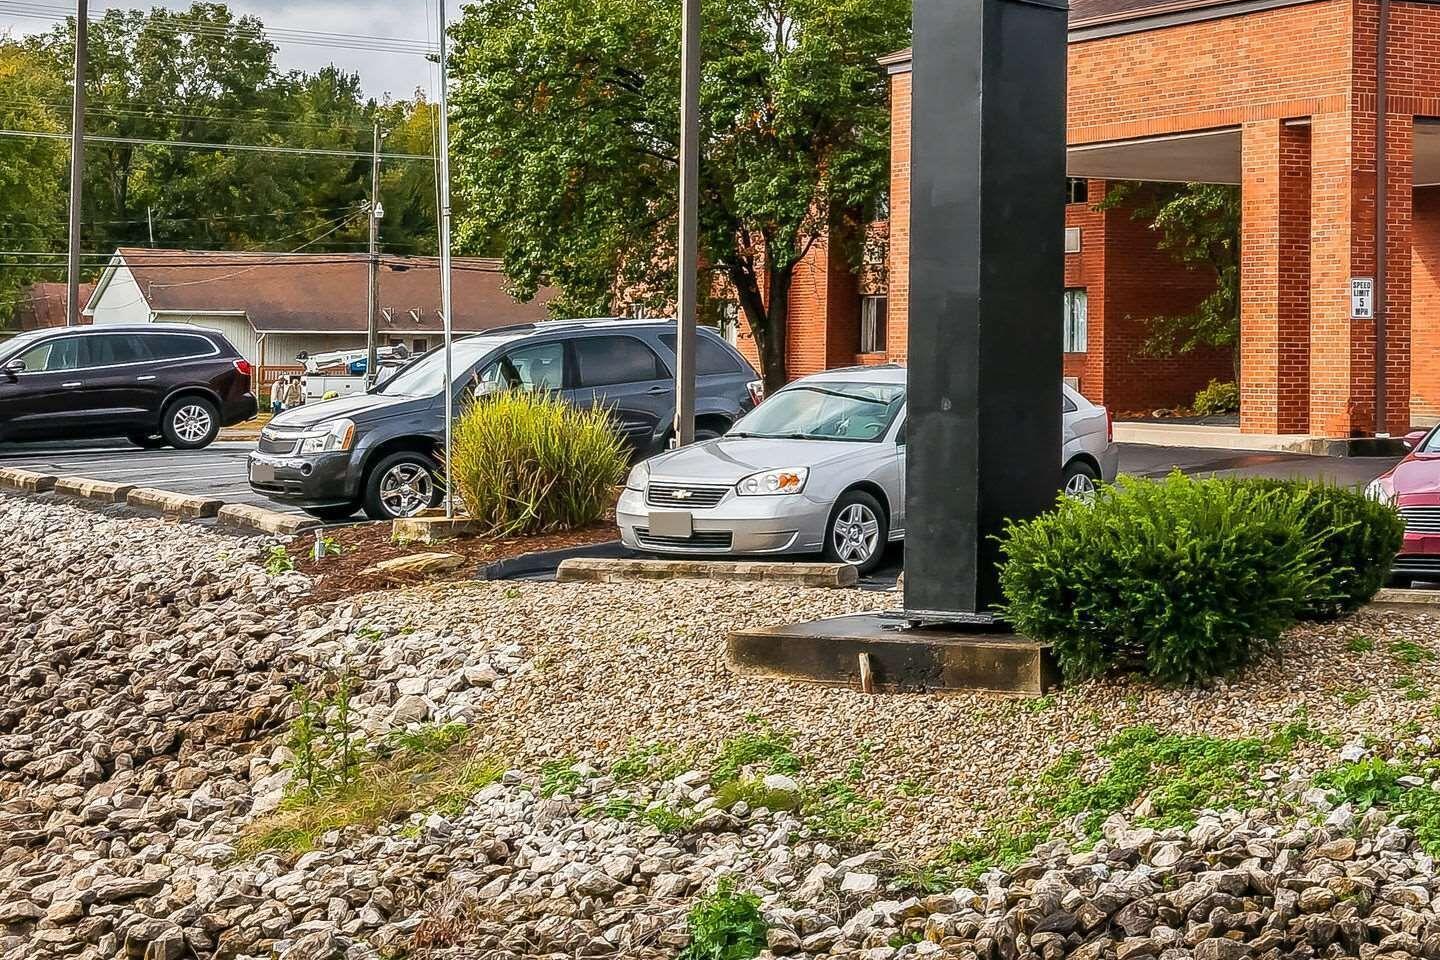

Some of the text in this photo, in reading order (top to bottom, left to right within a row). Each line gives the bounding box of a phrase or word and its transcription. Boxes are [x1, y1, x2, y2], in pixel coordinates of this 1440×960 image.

[1353, 281, 1371, 289] SPEED
[1353, 289, 1370, 297] LIMIT
[1359, 297, 1365, 307] 5
[1355, 307, 1369, 316] MPH
